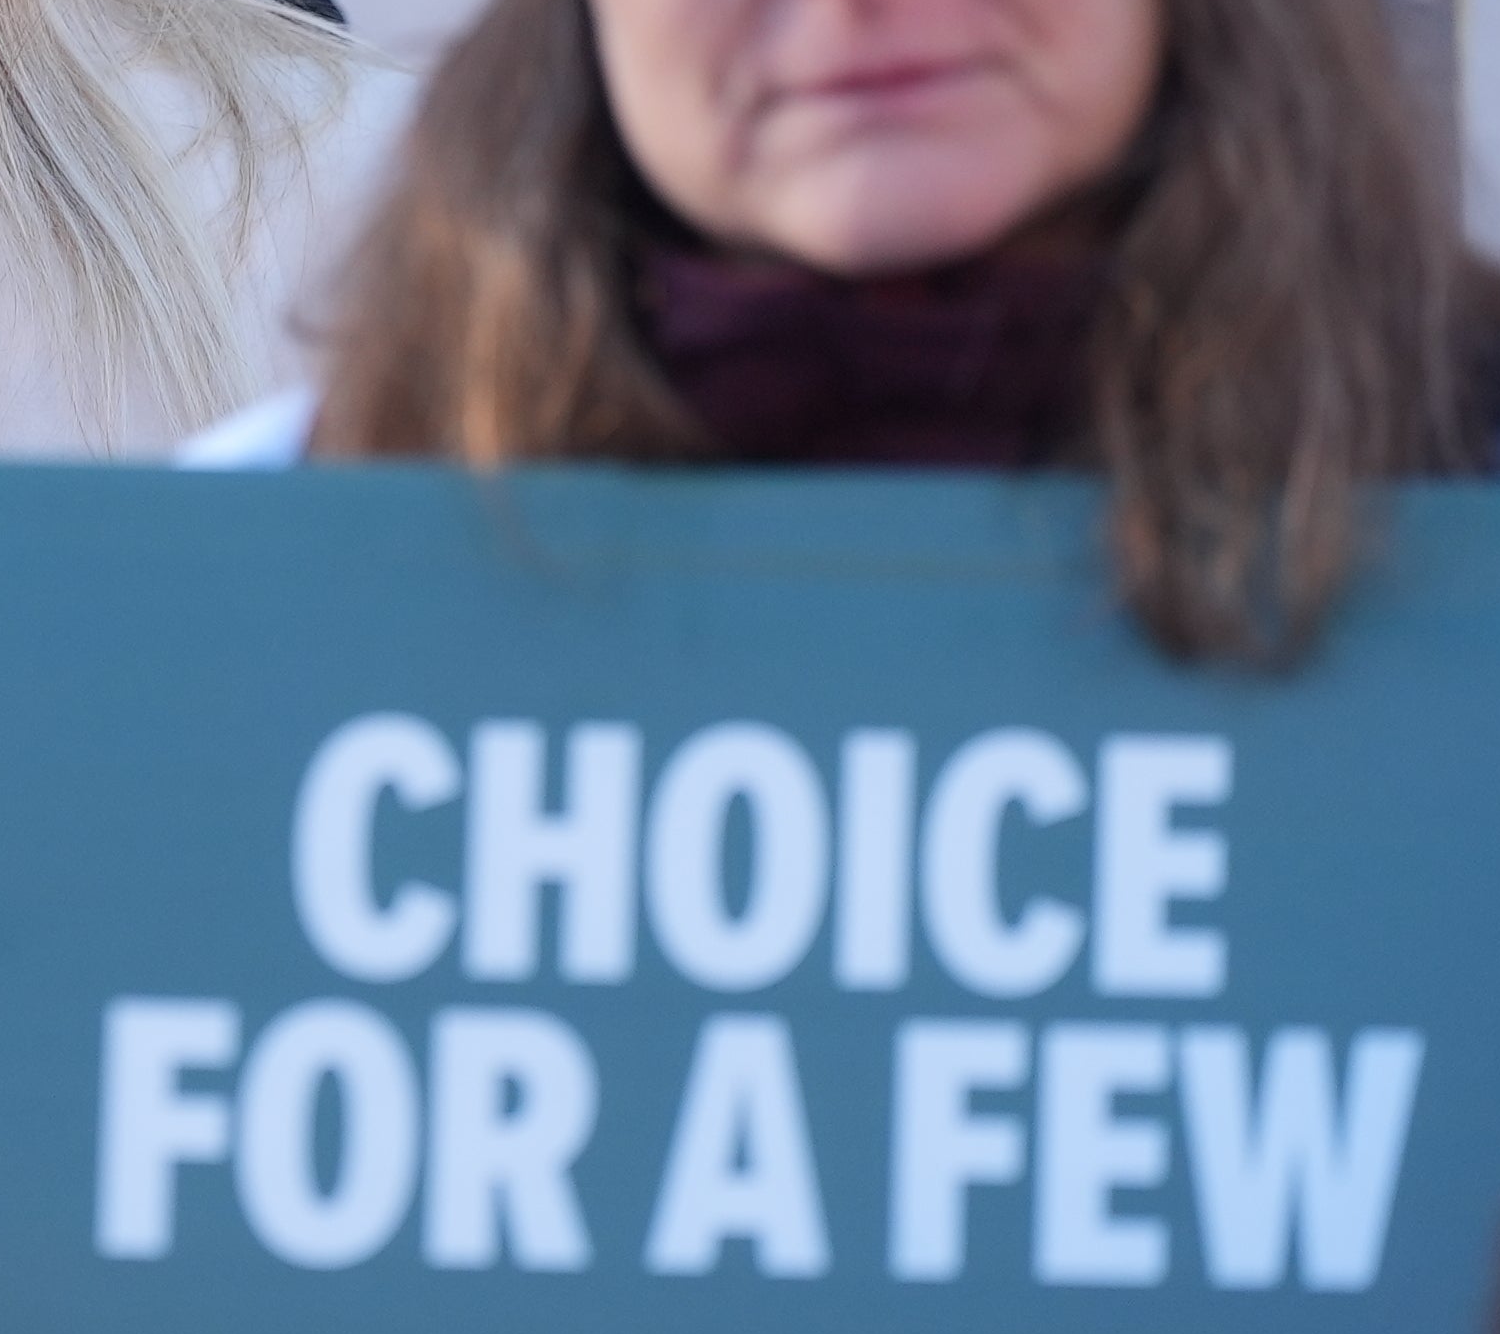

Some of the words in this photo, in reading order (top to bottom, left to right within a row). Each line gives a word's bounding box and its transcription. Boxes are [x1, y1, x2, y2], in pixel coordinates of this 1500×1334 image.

[290, 712, 1234, 997] CHOICE
[97, 996, 600, 1271] FOR
[644, 1014, 829, 1275] A
[888, 1018, 1426, 1293] FEW
